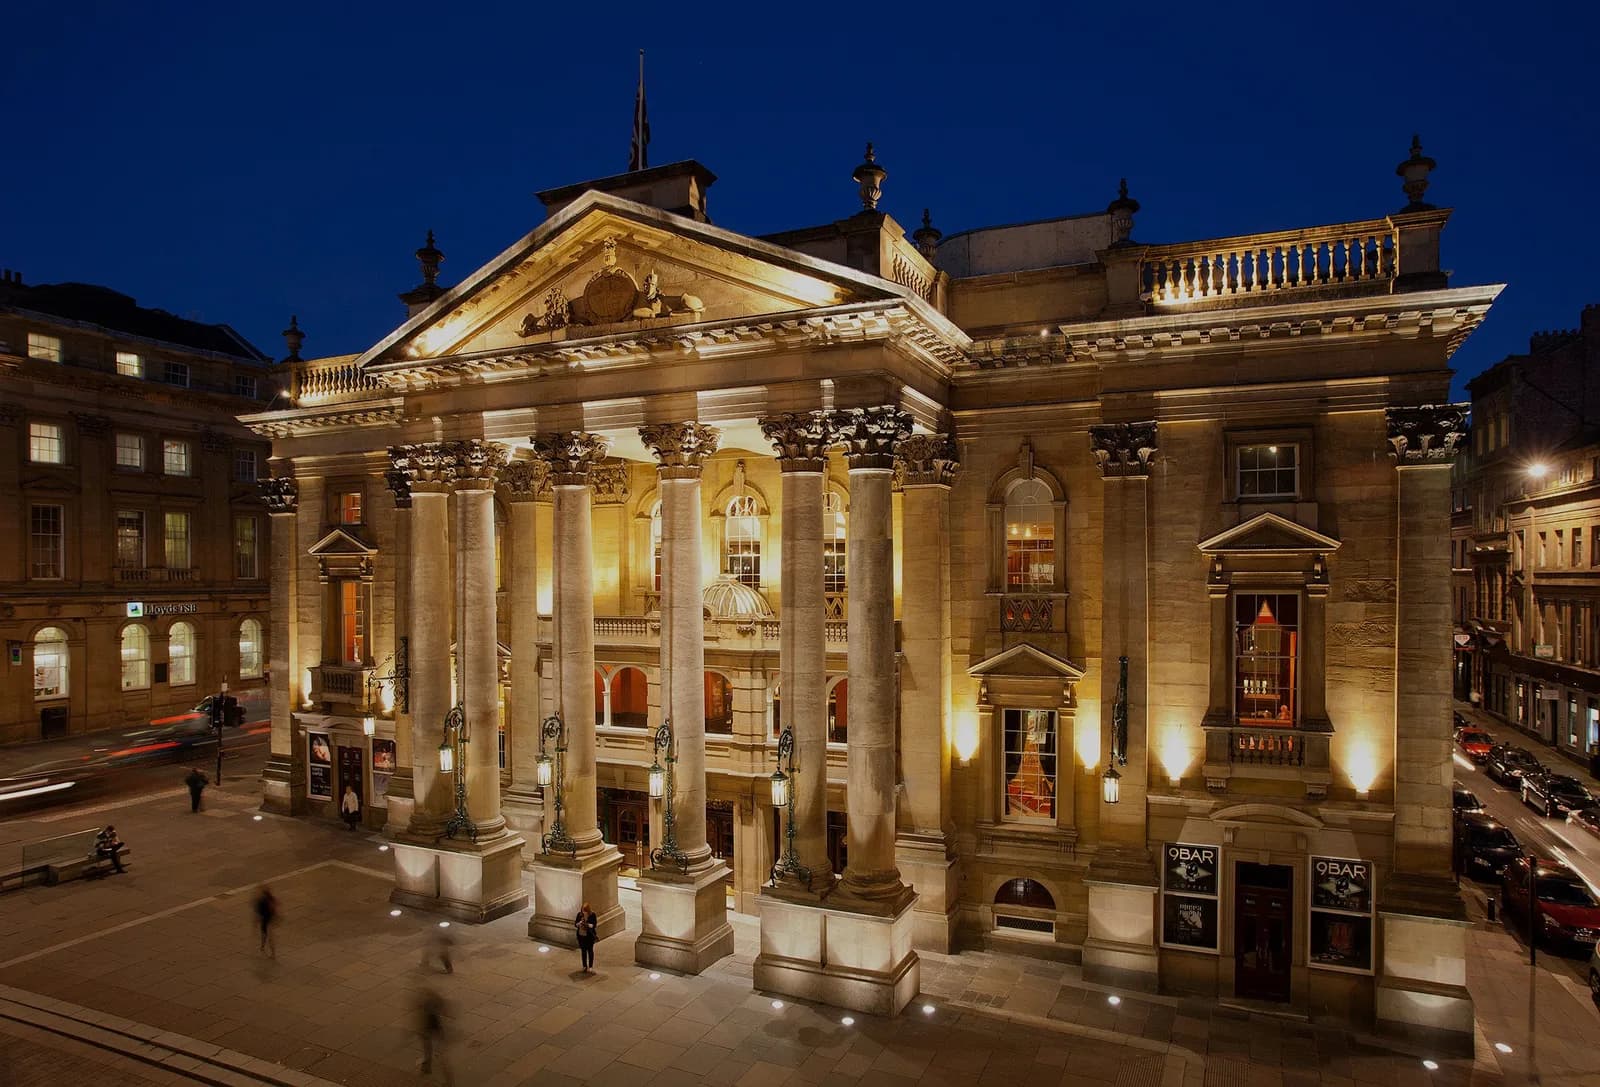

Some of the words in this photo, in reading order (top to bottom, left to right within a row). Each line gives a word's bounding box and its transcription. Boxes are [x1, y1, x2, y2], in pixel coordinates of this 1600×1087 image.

[145, 604, 178, 616] Lloyds
[1168, 847, 1213, 865] 9BAR
[1316, 861, 1367, 880] 9BAR
